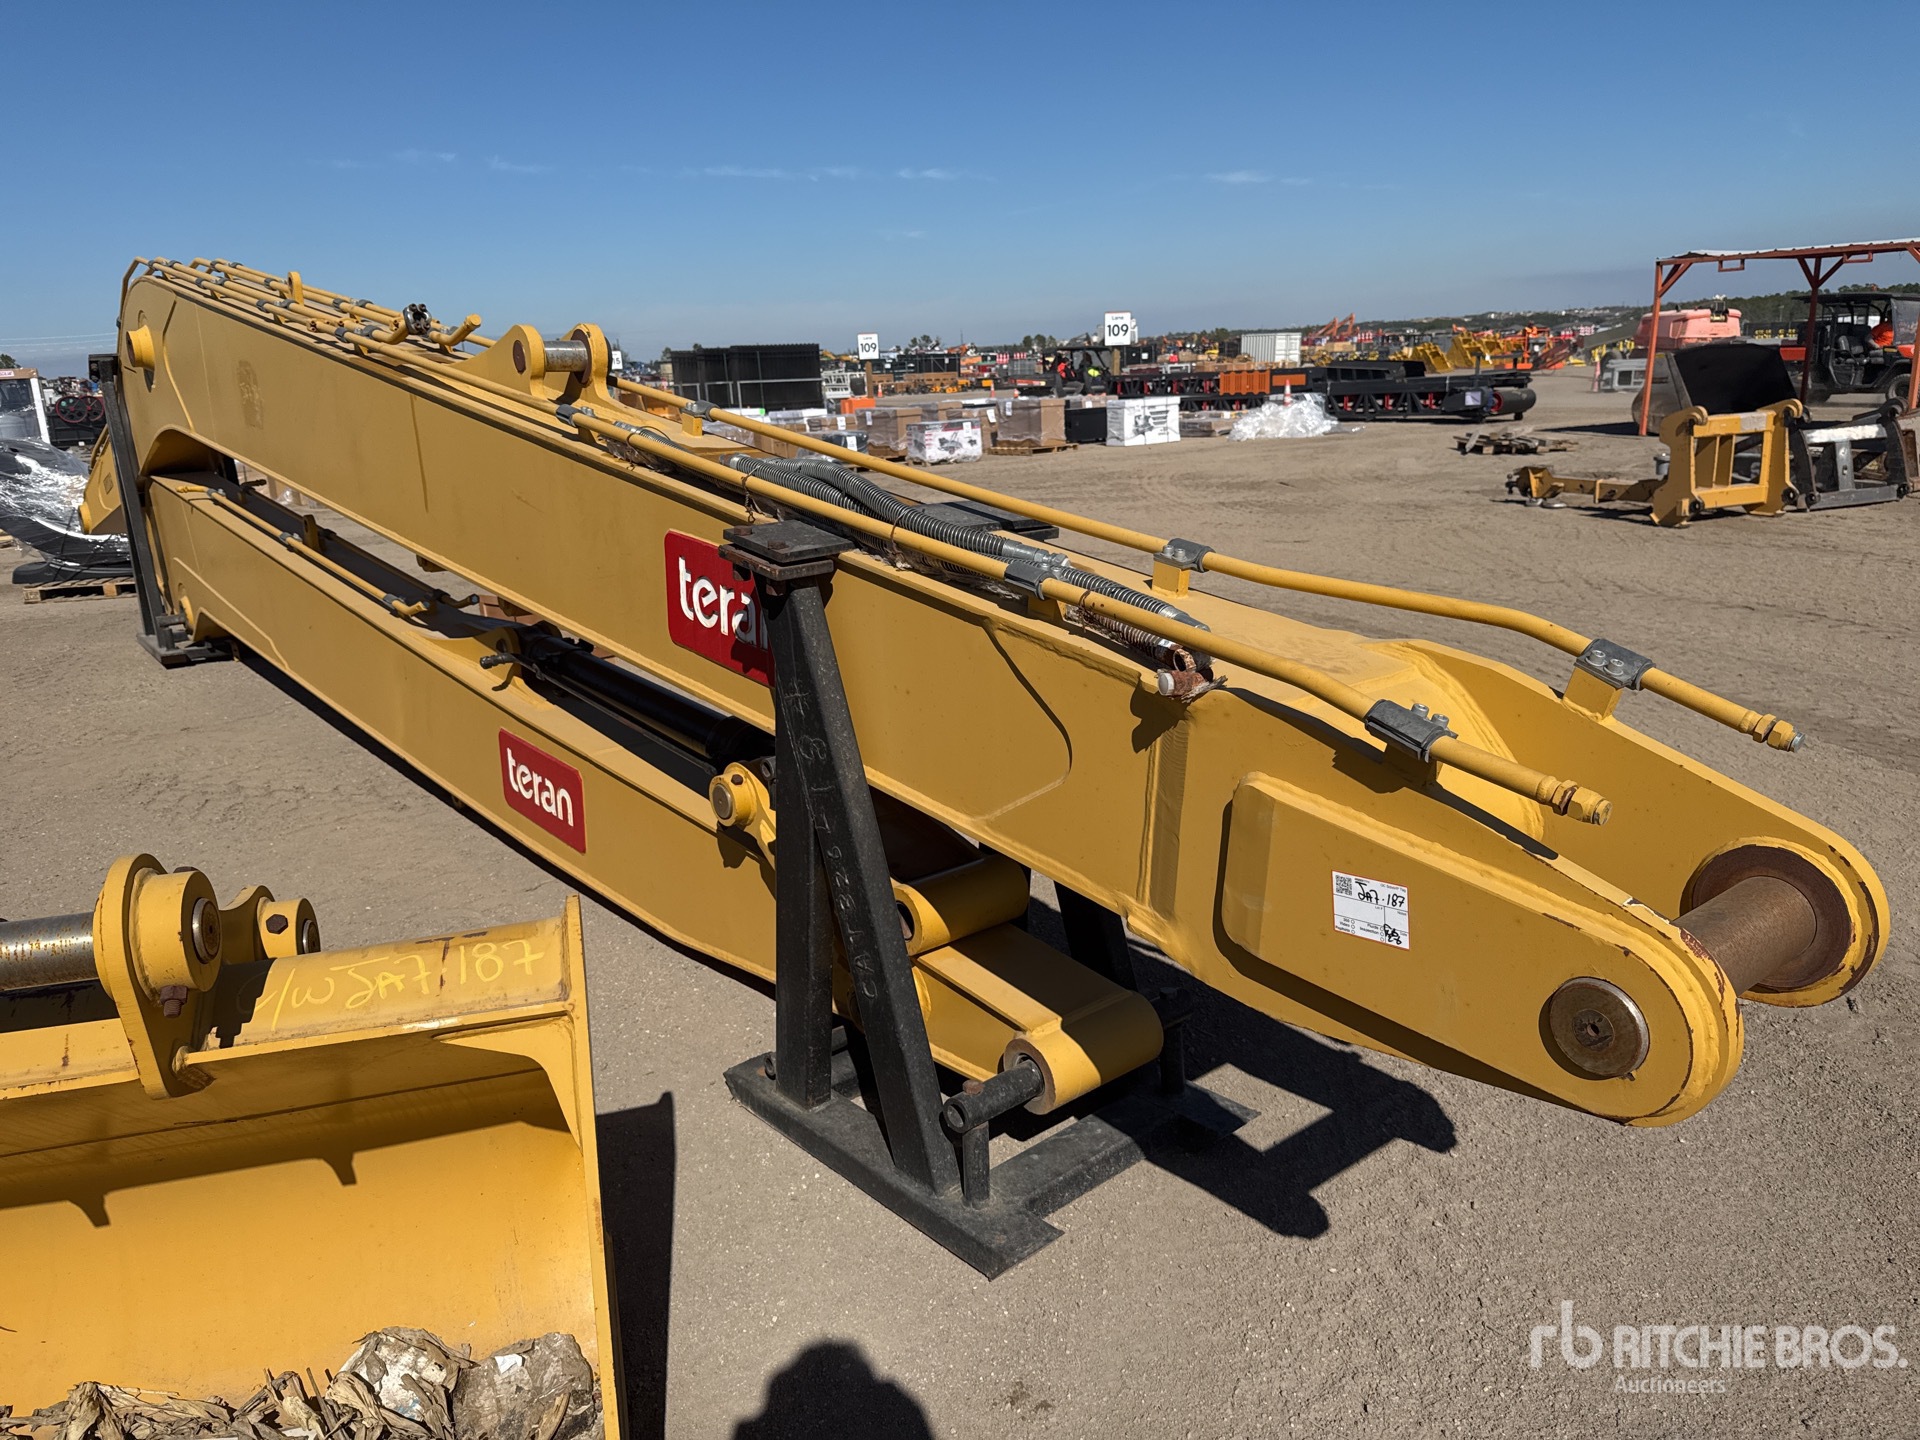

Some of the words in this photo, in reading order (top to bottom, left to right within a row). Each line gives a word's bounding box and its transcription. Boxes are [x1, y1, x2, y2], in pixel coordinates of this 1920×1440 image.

[1107, 323, 1129, 337] 109
[860, 342, 877, 353] 109
[506, 747, 574, 827] teran
